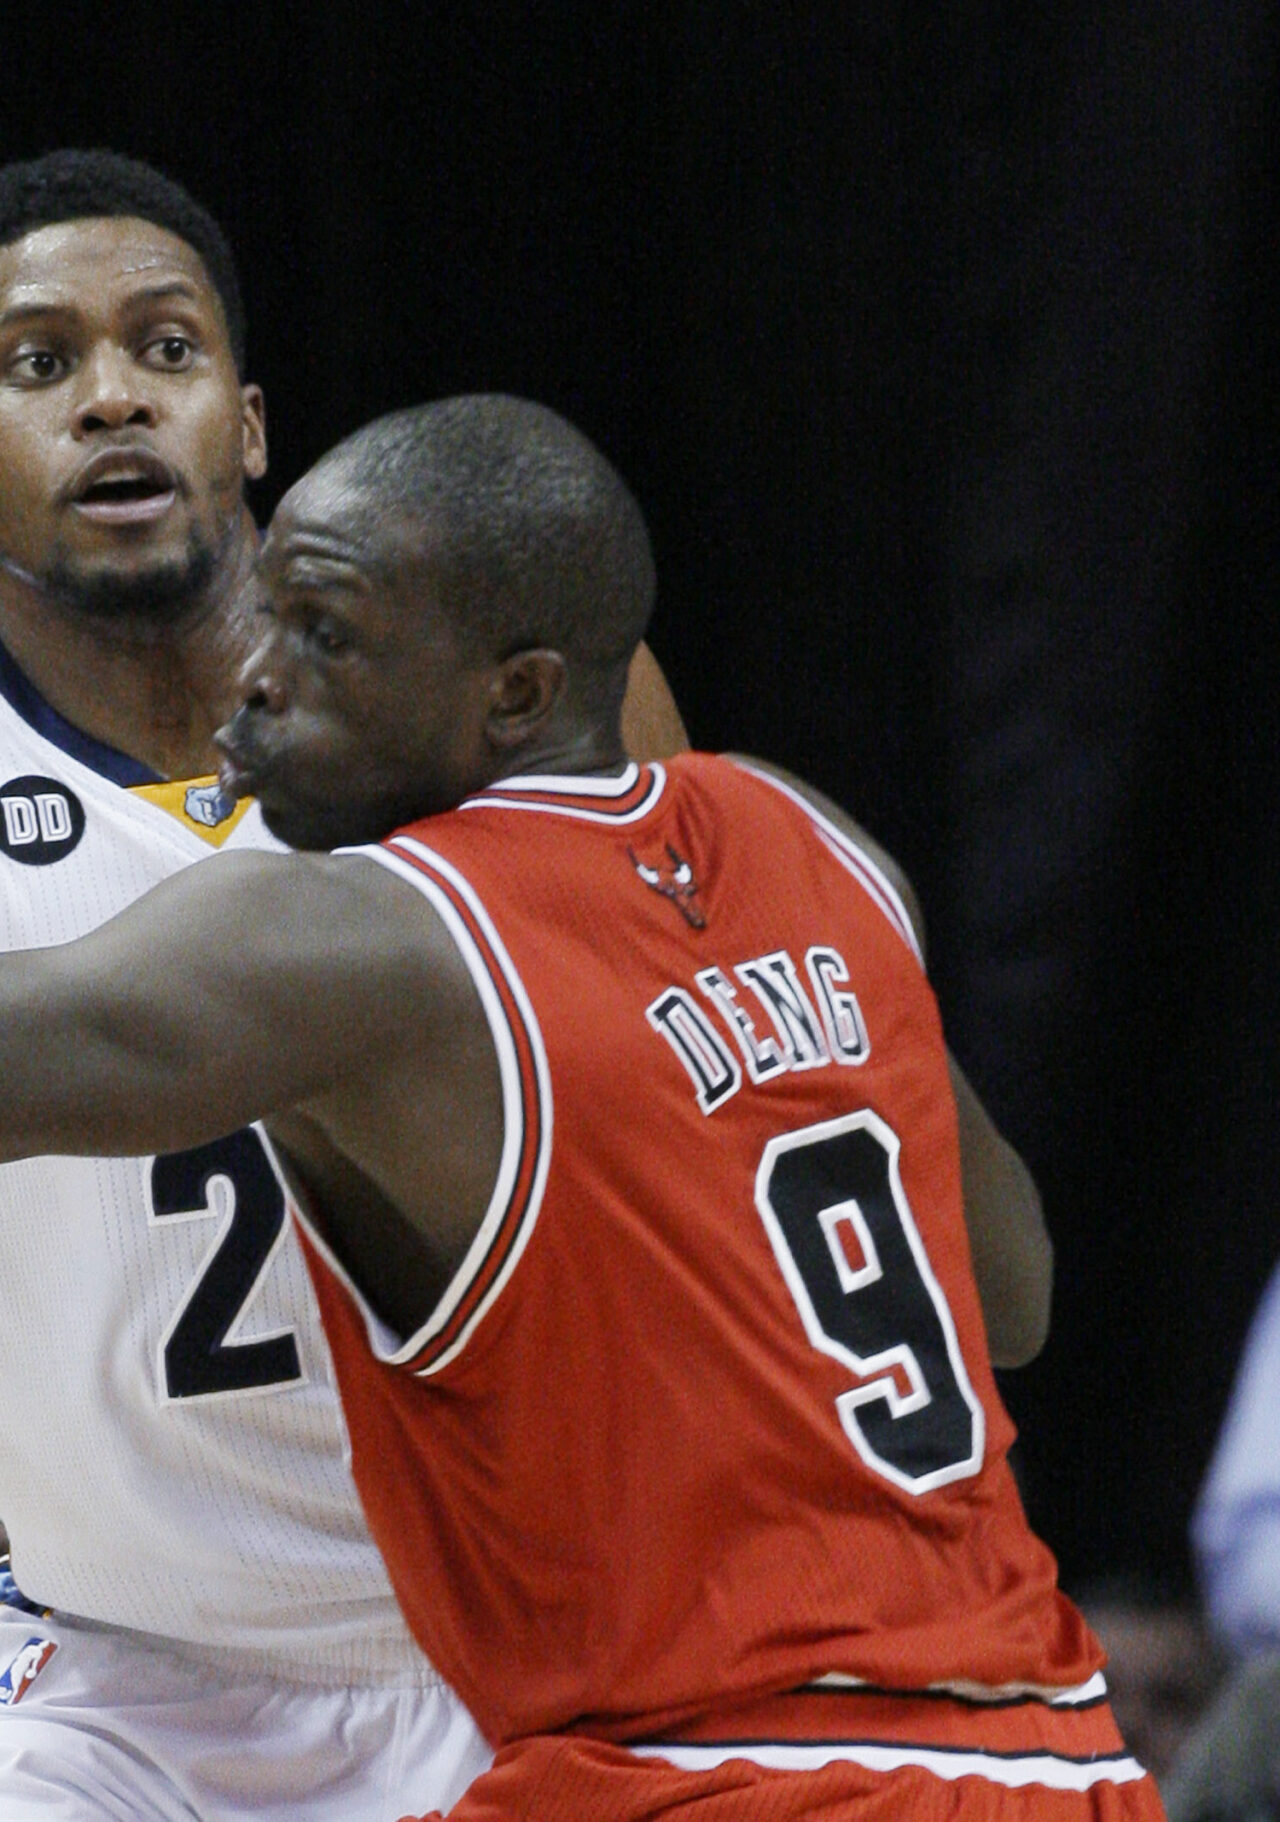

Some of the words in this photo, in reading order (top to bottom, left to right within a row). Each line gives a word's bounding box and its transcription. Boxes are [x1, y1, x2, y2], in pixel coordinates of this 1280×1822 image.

[0, 793, 72, 846] DD
[645, 945, 871, 1116] DENG
[144, 1121, 308, 1407] 2
[754, 1108, 986, 1496] 9
